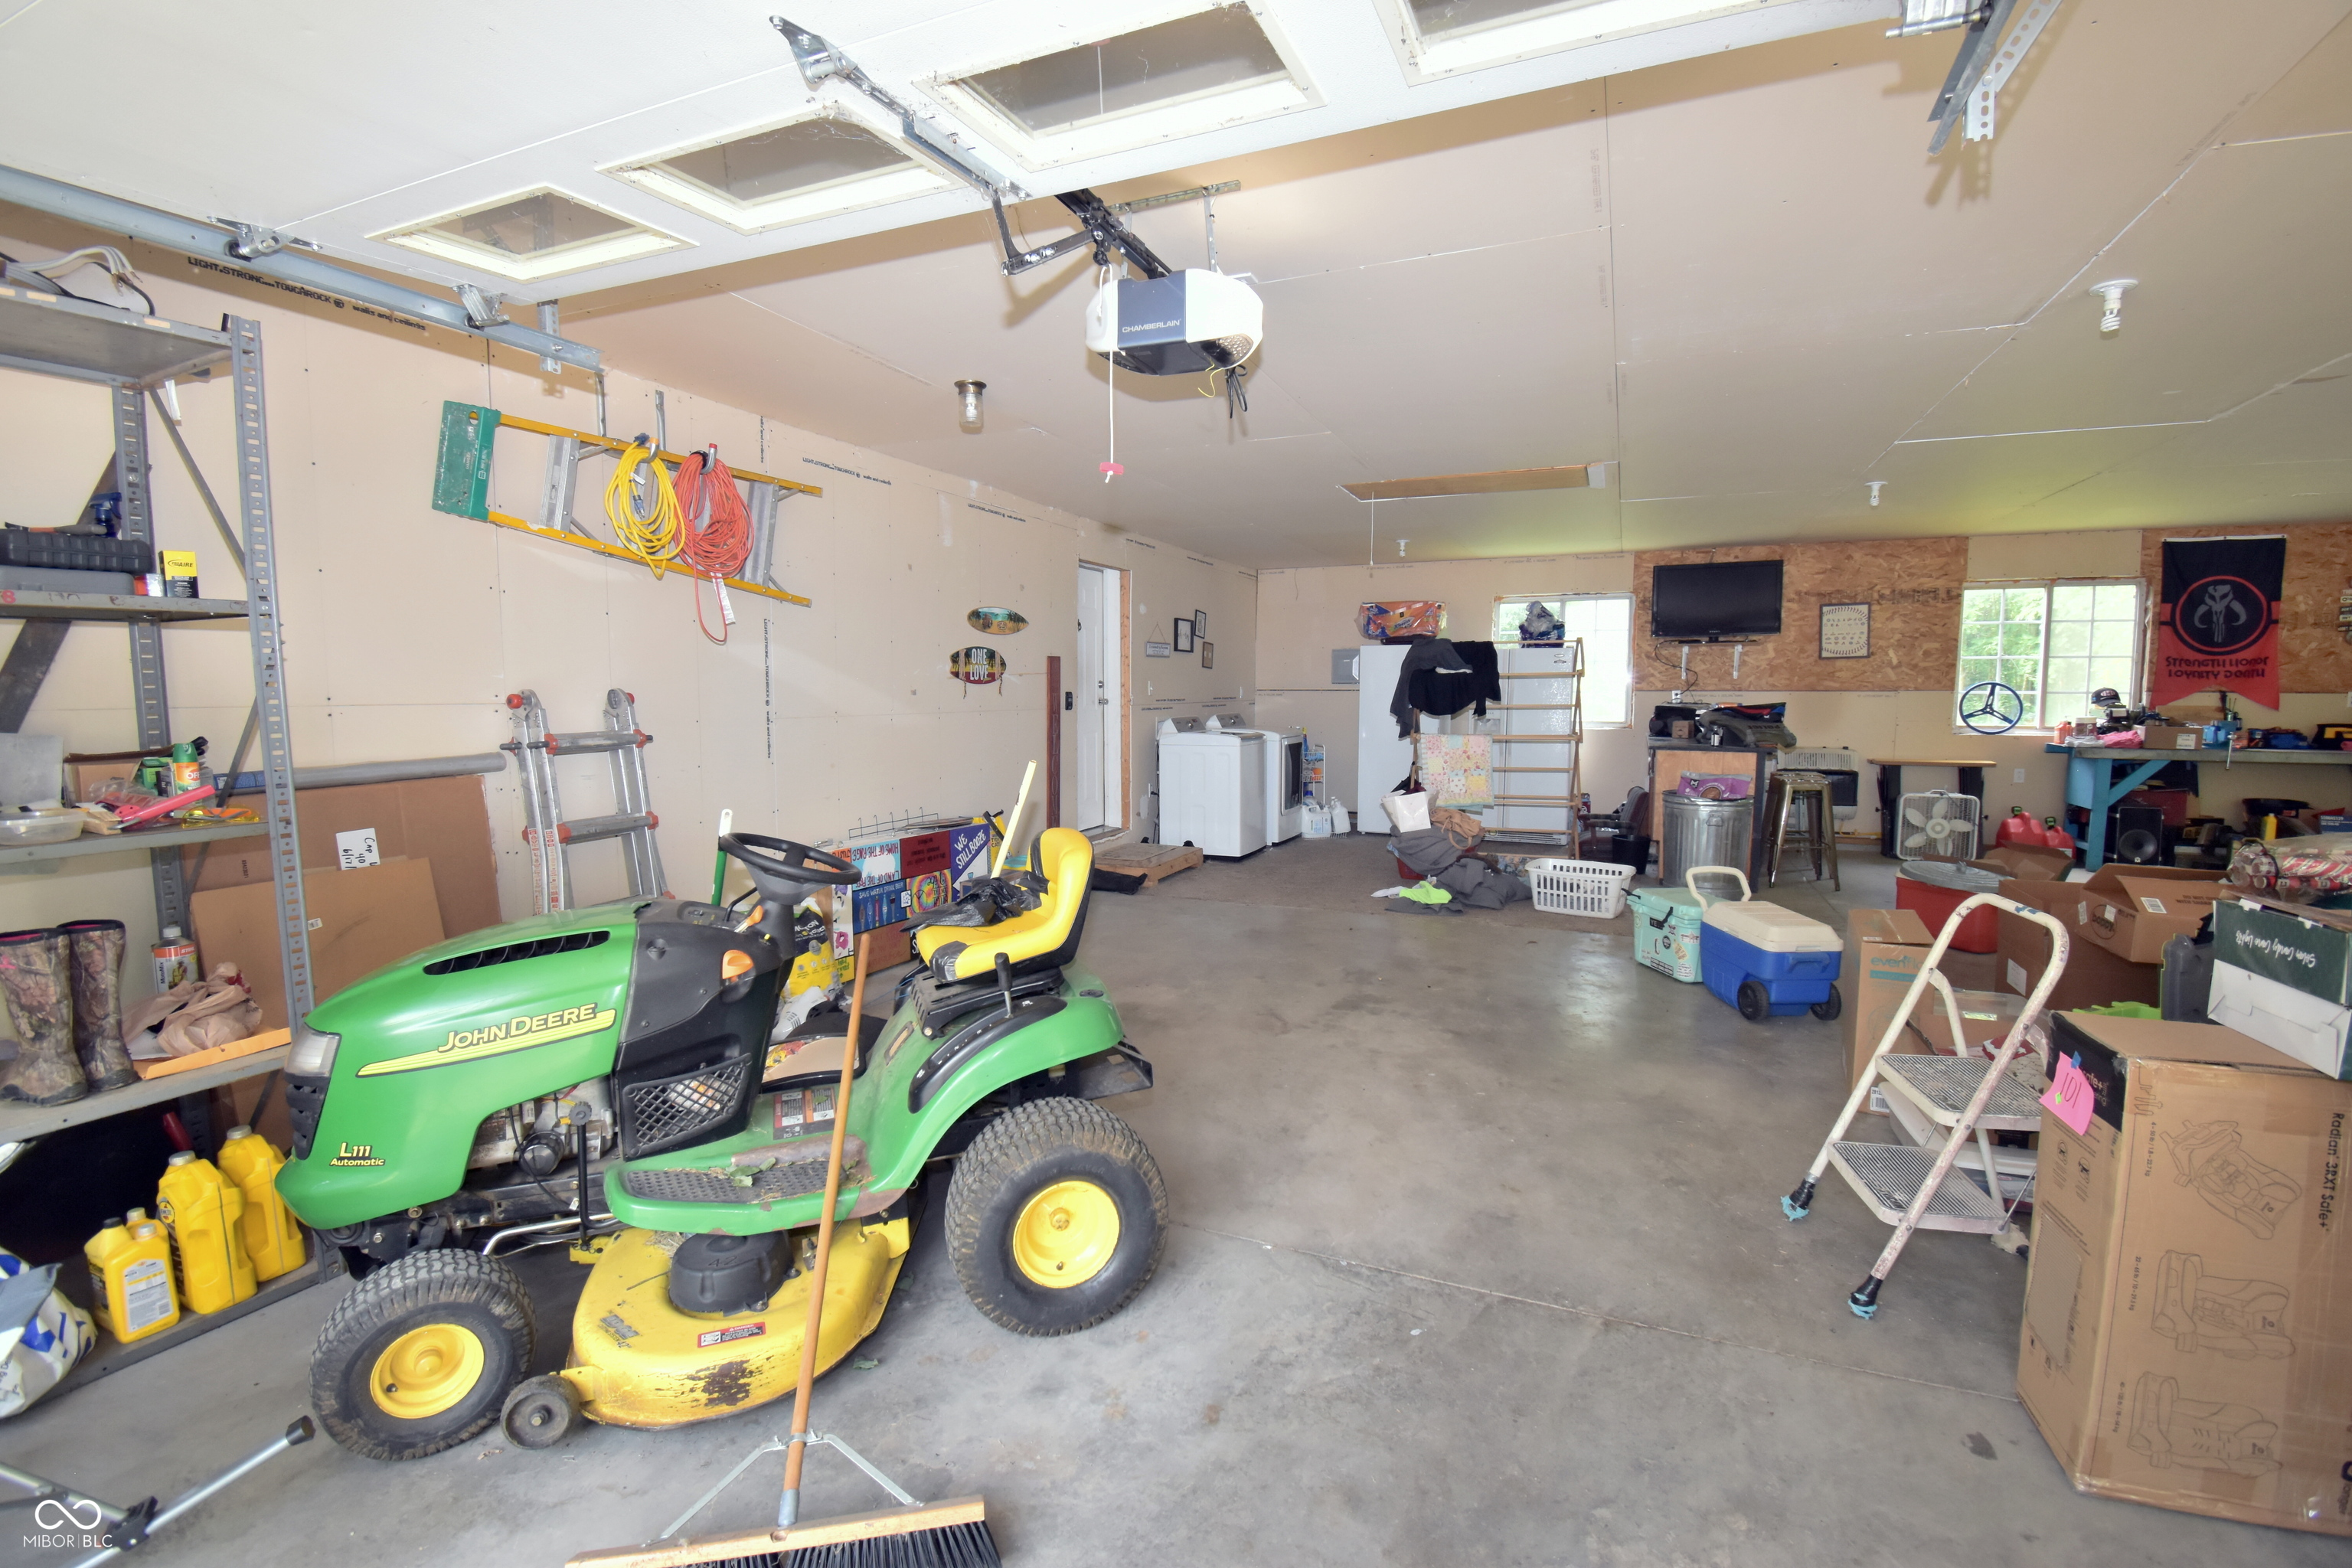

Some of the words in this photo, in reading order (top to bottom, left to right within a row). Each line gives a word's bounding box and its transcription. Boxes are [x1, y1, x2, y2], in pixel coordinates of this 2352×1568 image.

[352, 305, 375, 316] walls
[1122, 320, 1180, 333] CHAMBERLAIN
[972, 648, 988, 664] ONE
[970, 664, 989, 681] LOVE
[954, 833, 968, 851] WE
[956, 847, 973, 870] STILL
[969, 829, 986, 858] BOOZE
[859, 890, 870, 899] SAVE
[2272, 938, 2294, 961] Candy
[438, 1024, 508, 1053] JOHN
[508, 1002, 598, 1037] DEERE
[339, 1142, 372, 1157] L111
[330, 1158, 385, 1166] Automatic
[2323, 1162, 2337, 1191] 3RXT
